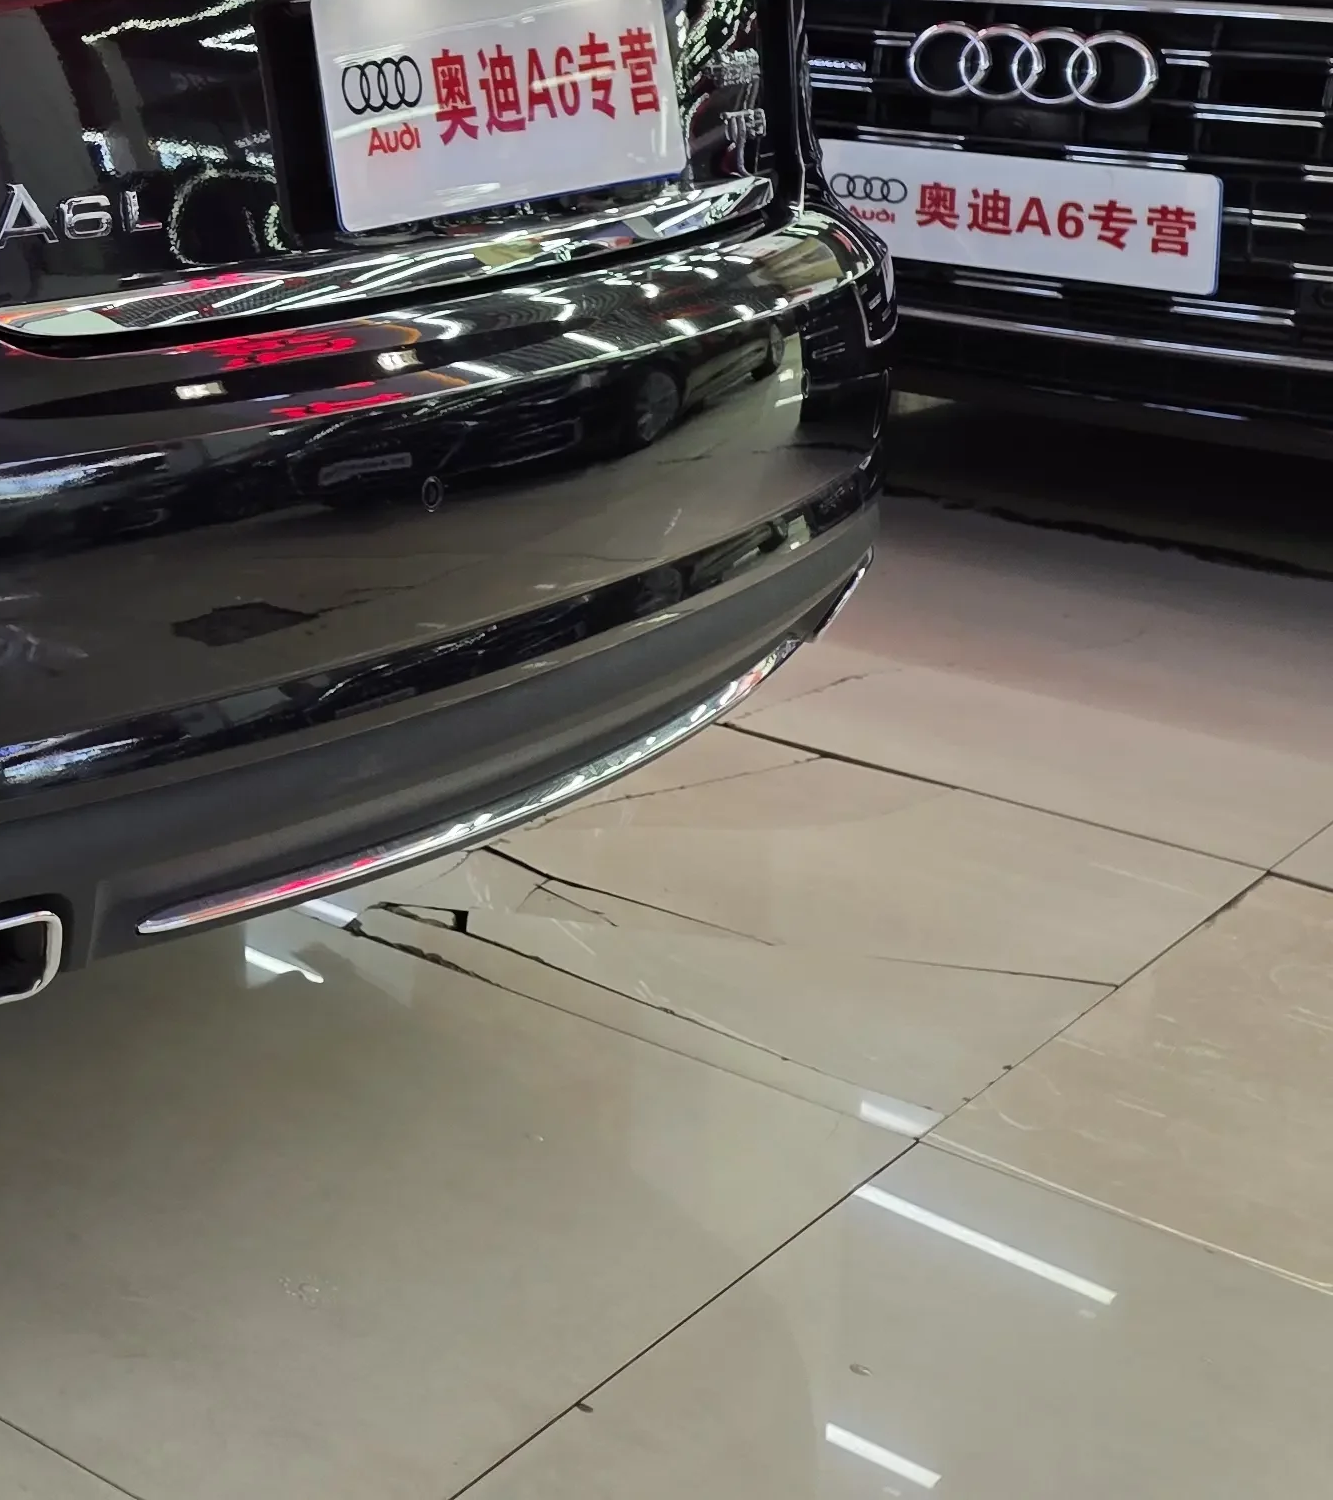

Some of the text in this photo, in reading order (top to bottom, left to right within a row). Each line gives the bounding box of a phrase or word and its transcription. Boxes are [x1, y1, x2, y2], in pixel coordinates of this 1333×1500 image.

[430, 26, 660, 146] 奥迪A6专营
[367, 125, 422, 157] Audi
[848, 203, 896, 225] Audi
[915, 181, 1197, 257] 奥迪A6专营
